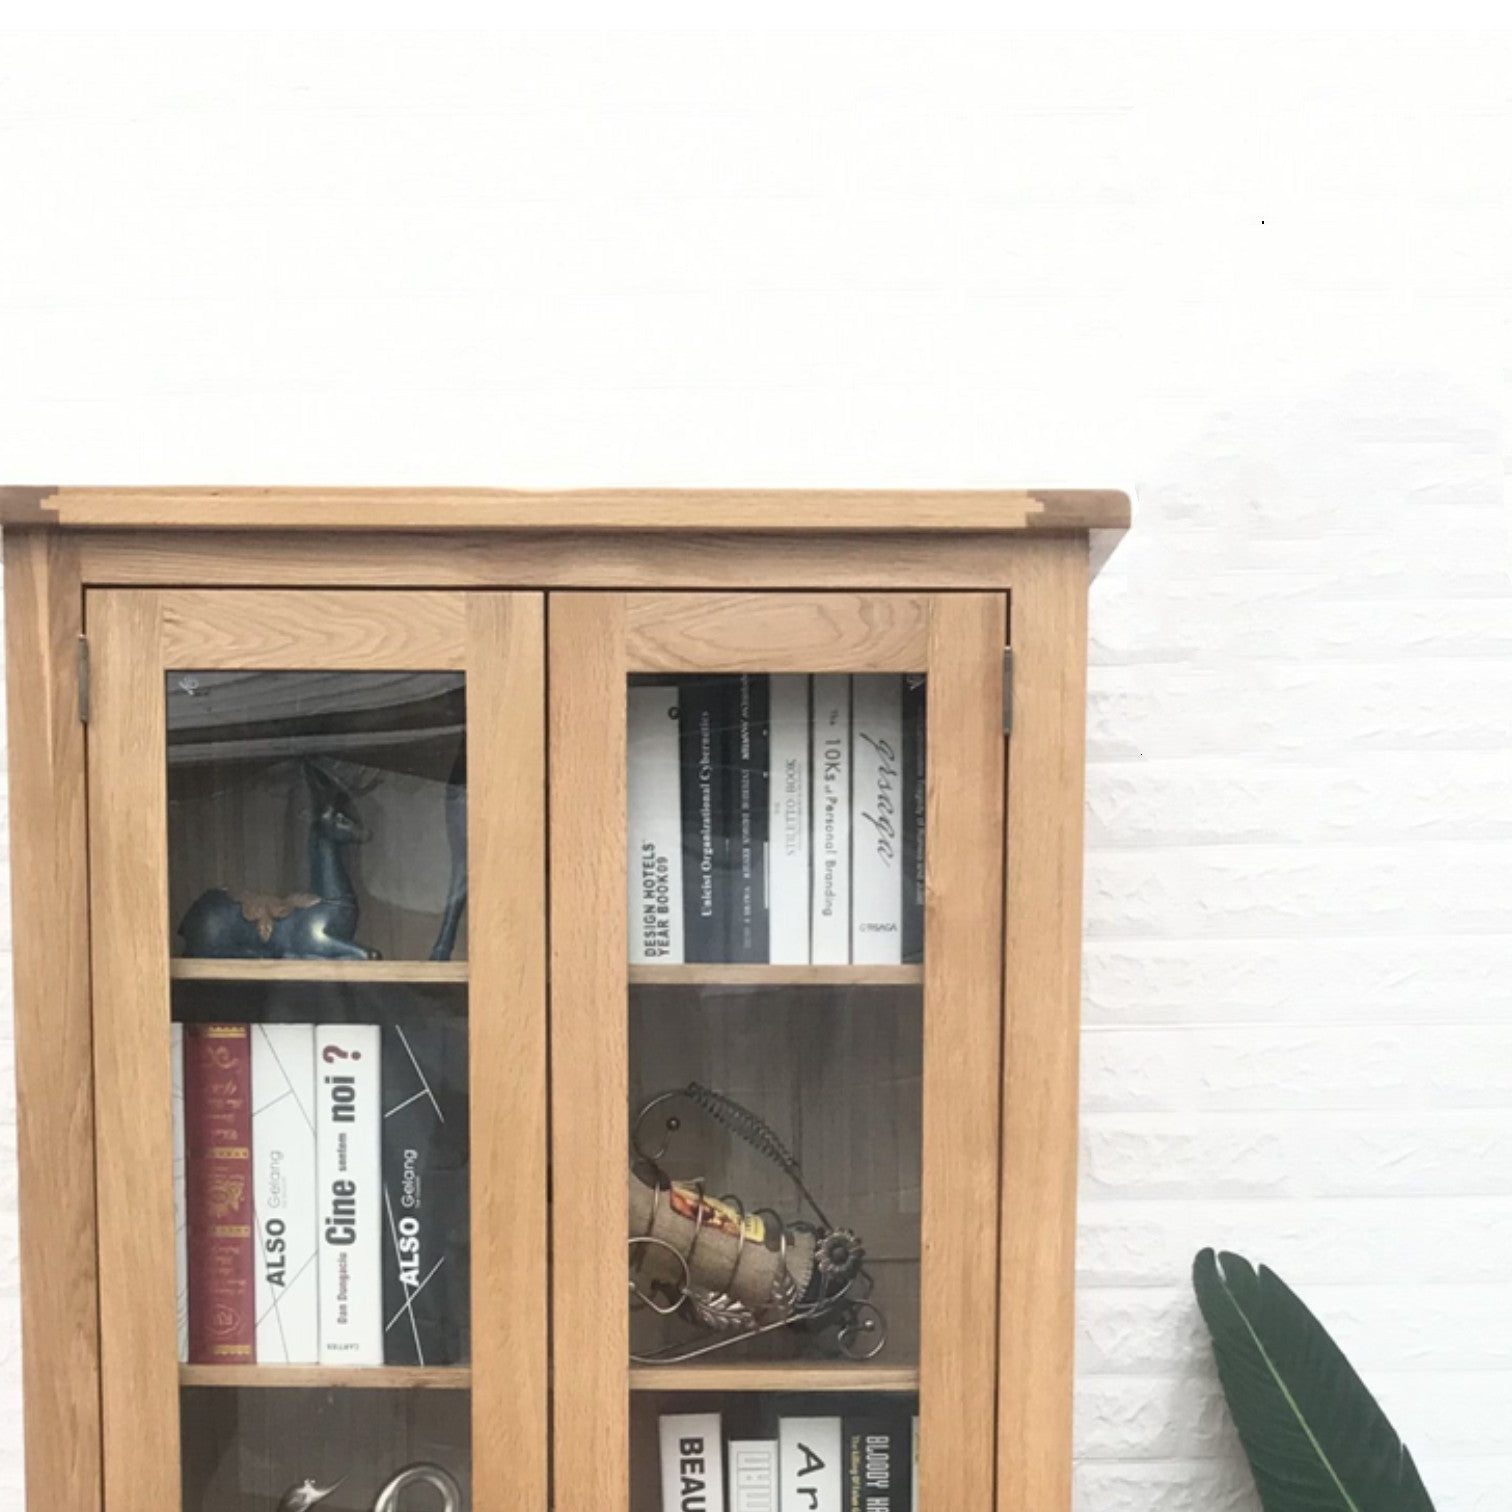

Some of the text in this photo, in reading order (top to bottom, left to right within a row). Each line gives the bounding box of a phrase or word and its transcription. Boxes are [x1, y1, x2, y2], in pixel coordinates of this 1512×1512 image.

[824, 738, 840, 782] 10Ks
[823, 796, 838, 855] Personal
[642, 842, 656, 957] DESIGN HOTELS
[822, 859, 836, 917] Branding
[656, 918, 670, 956] YEAR
[322, 1045, 361, 1064] ?
[324, 1076, 356, 1122] noi
[264, 1150, 286, 1288] ALSO Gelang
[325, 1180, 356, 1246] Cine
[399, 1149, 419, 1287] ALSO Gelang
[866, 1435, 890, 1488] BLOODY
